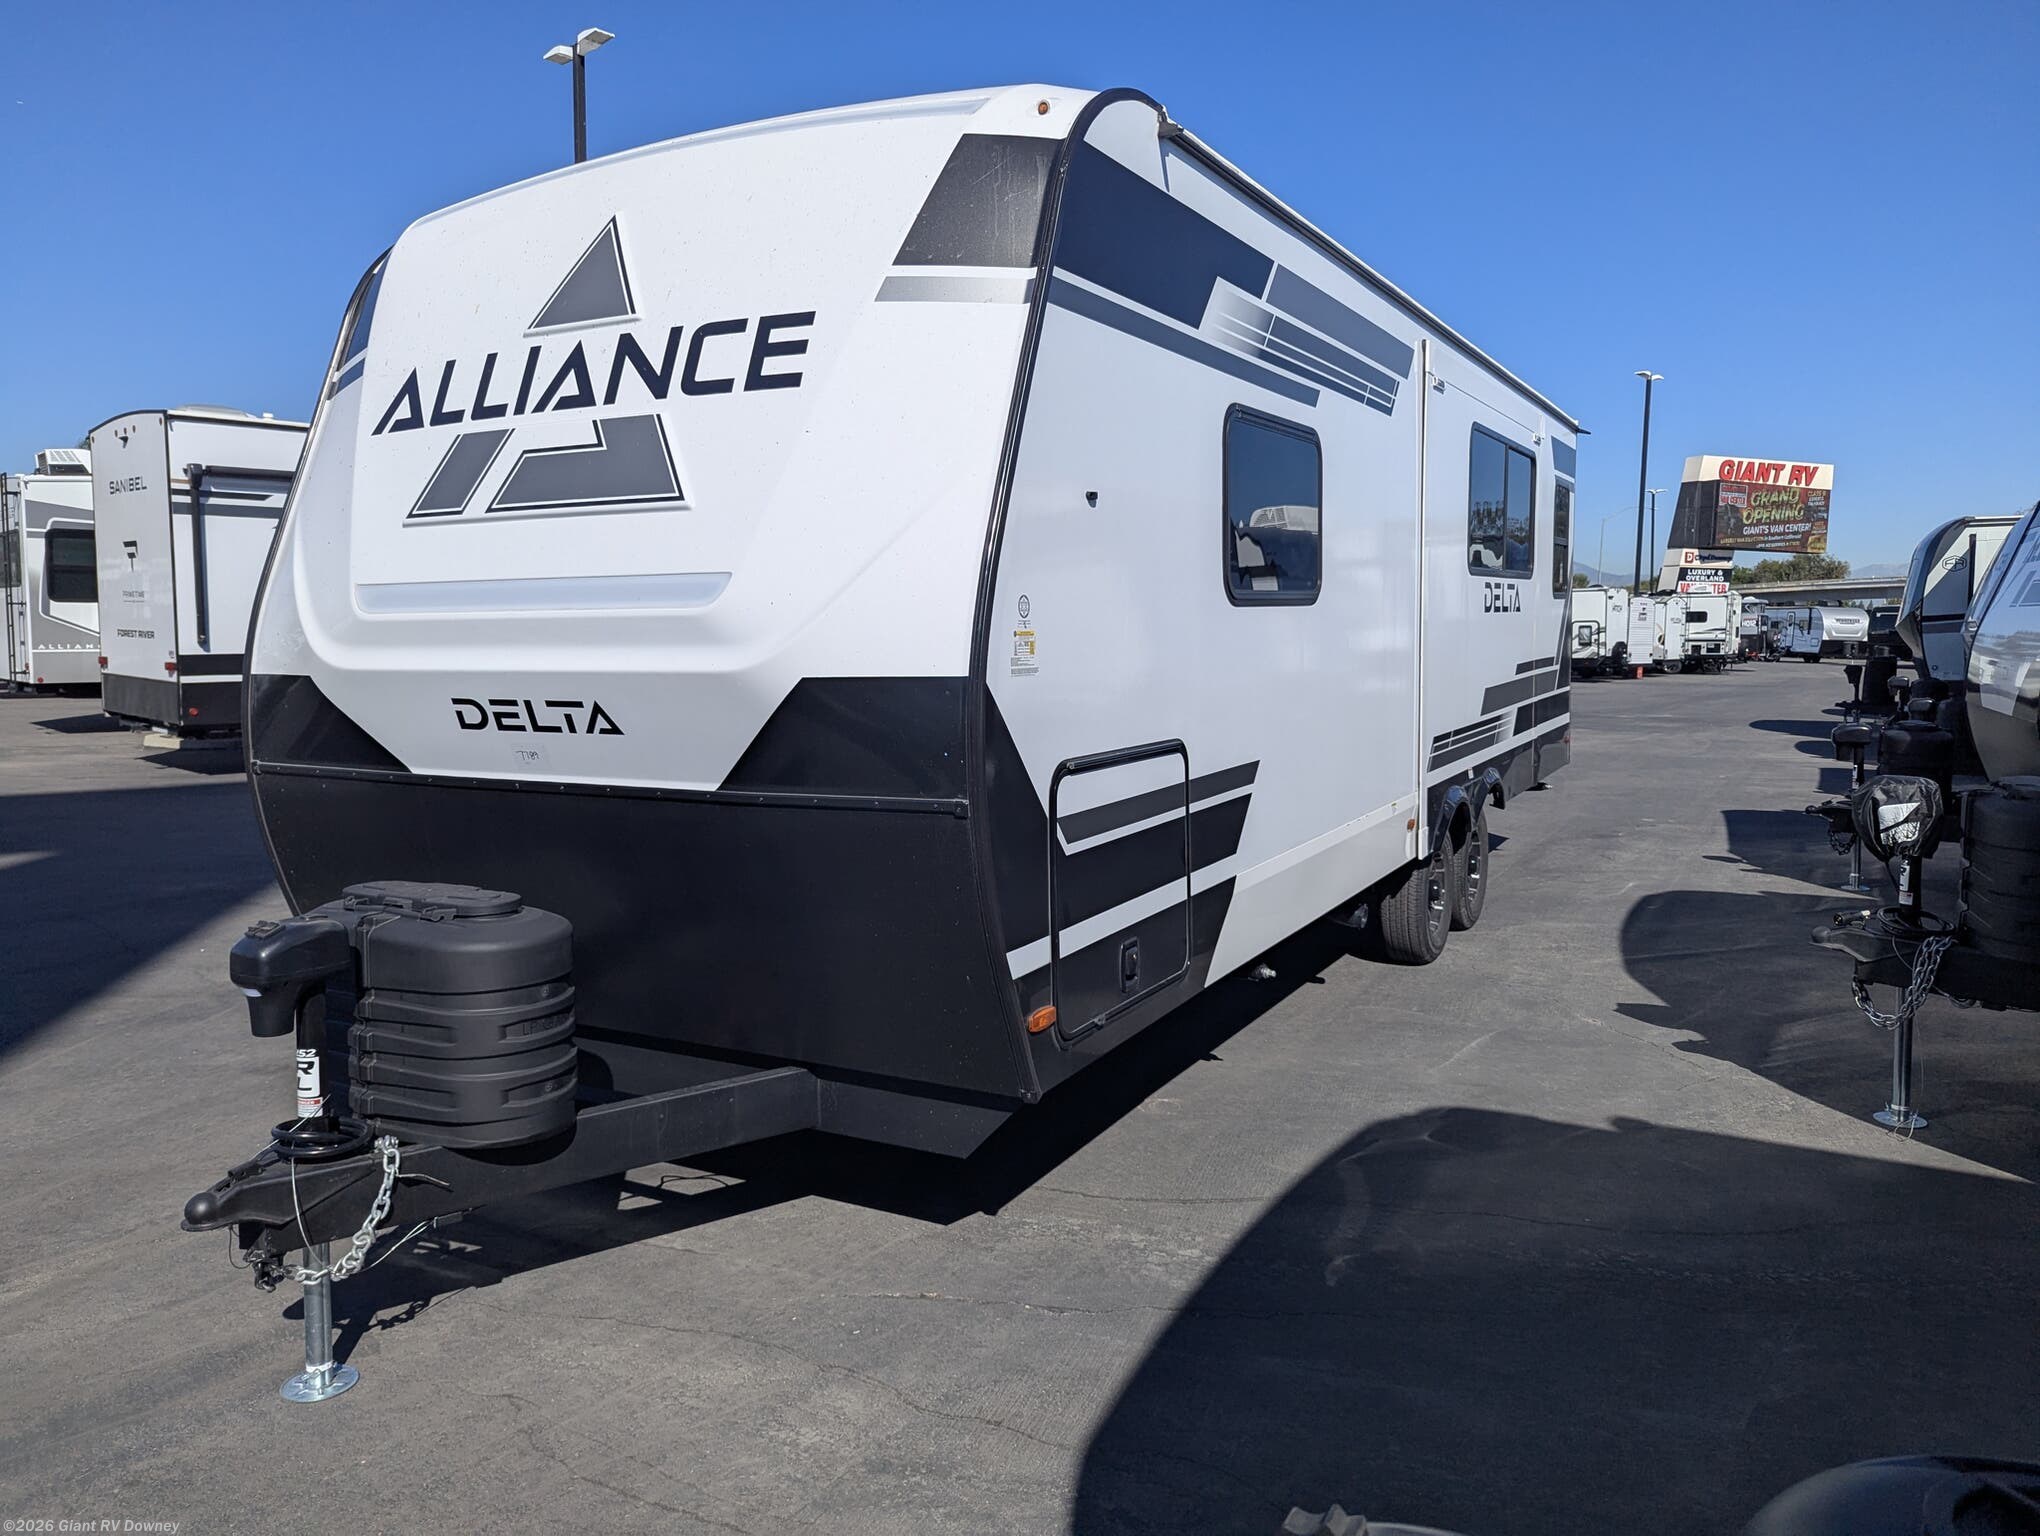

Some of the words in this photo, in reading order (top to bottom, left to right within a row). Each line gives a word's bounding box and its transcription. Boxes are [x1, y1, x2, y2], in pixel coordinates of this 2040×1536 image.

[372, 310, 816, 436] ALLIANCE
[1718, 459, 1786, 484] GIANT
[1788, 464, 1819, 487] RV
[109, 475, 148, 495] SANIBEL
[1751, 487, 1800, 506] GRAND
[1742, 503, 1805, 525] OPENING
[1742, 525, 1769, 535] GIANT'S
[1770, 525, 1783, 534] VAN
[1784, 523, 1812, 533] CENTER!
[1484, 582, 1521, 613] DELTA
[117, 629, 137, 638] FOREST
[138, 630, 155, 639] RIVER
[450, 697, 625, 735] DELTA
